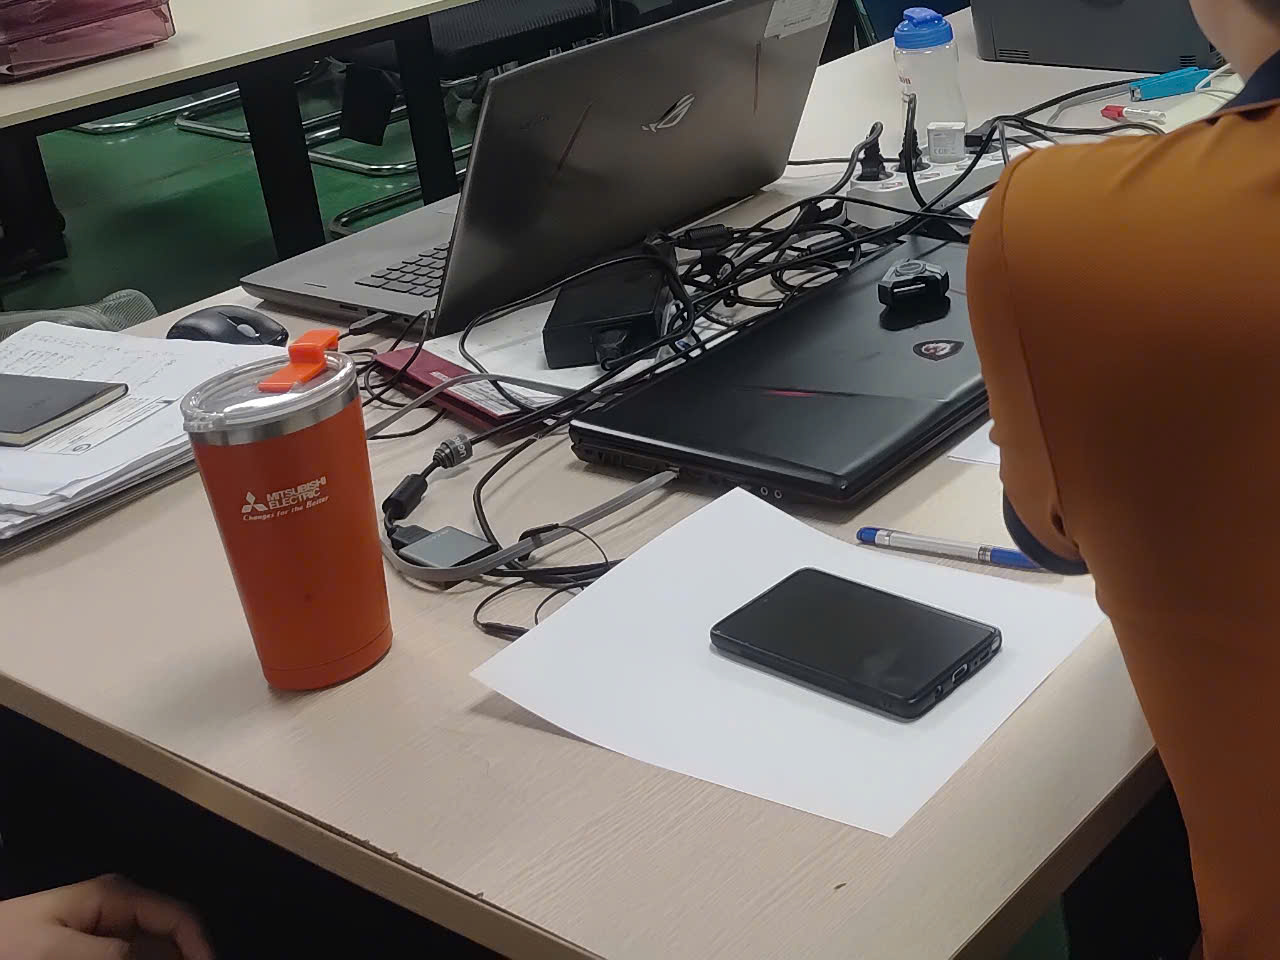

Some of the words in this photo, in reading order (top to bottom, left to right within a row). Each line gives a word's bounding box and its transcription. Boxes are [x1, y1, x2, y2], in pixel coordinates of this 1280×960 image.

[266, 476, 327, 502] MITSUBISHI
[269, 488, 321, 510] ELECTRIC
[243, 513, 274, 521] Changes
[306, 496, 329, 509] Better
